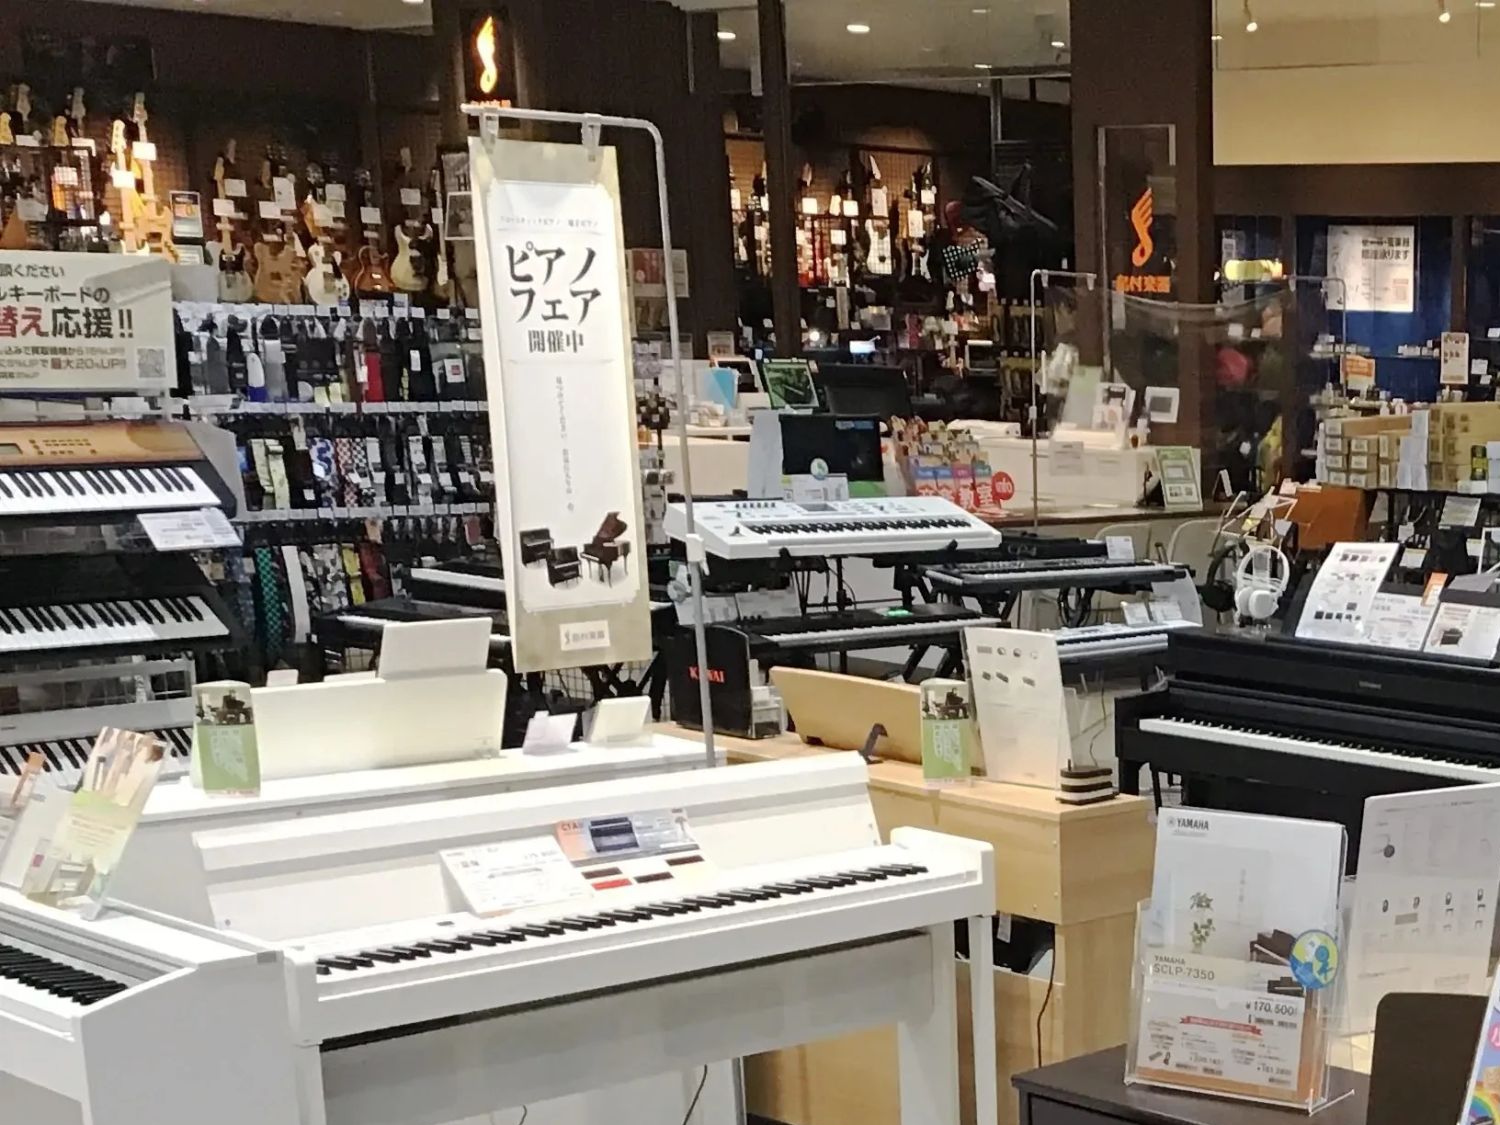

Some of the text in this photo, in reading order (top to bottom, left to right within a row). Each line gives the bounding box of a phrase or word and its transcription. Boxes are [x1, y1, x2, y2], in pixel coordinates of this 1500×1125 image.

[506, 240, 596, 285] ピアノ
[510, 288, 602, 325] フェア
[528, 329, 584, 353] 開催中
[1177, 818, 1209, 830] YAMAHA
[1154, 955, 1186, 965] YAMAHA
[1154, 964, 1215, 981] SCLP-7350
